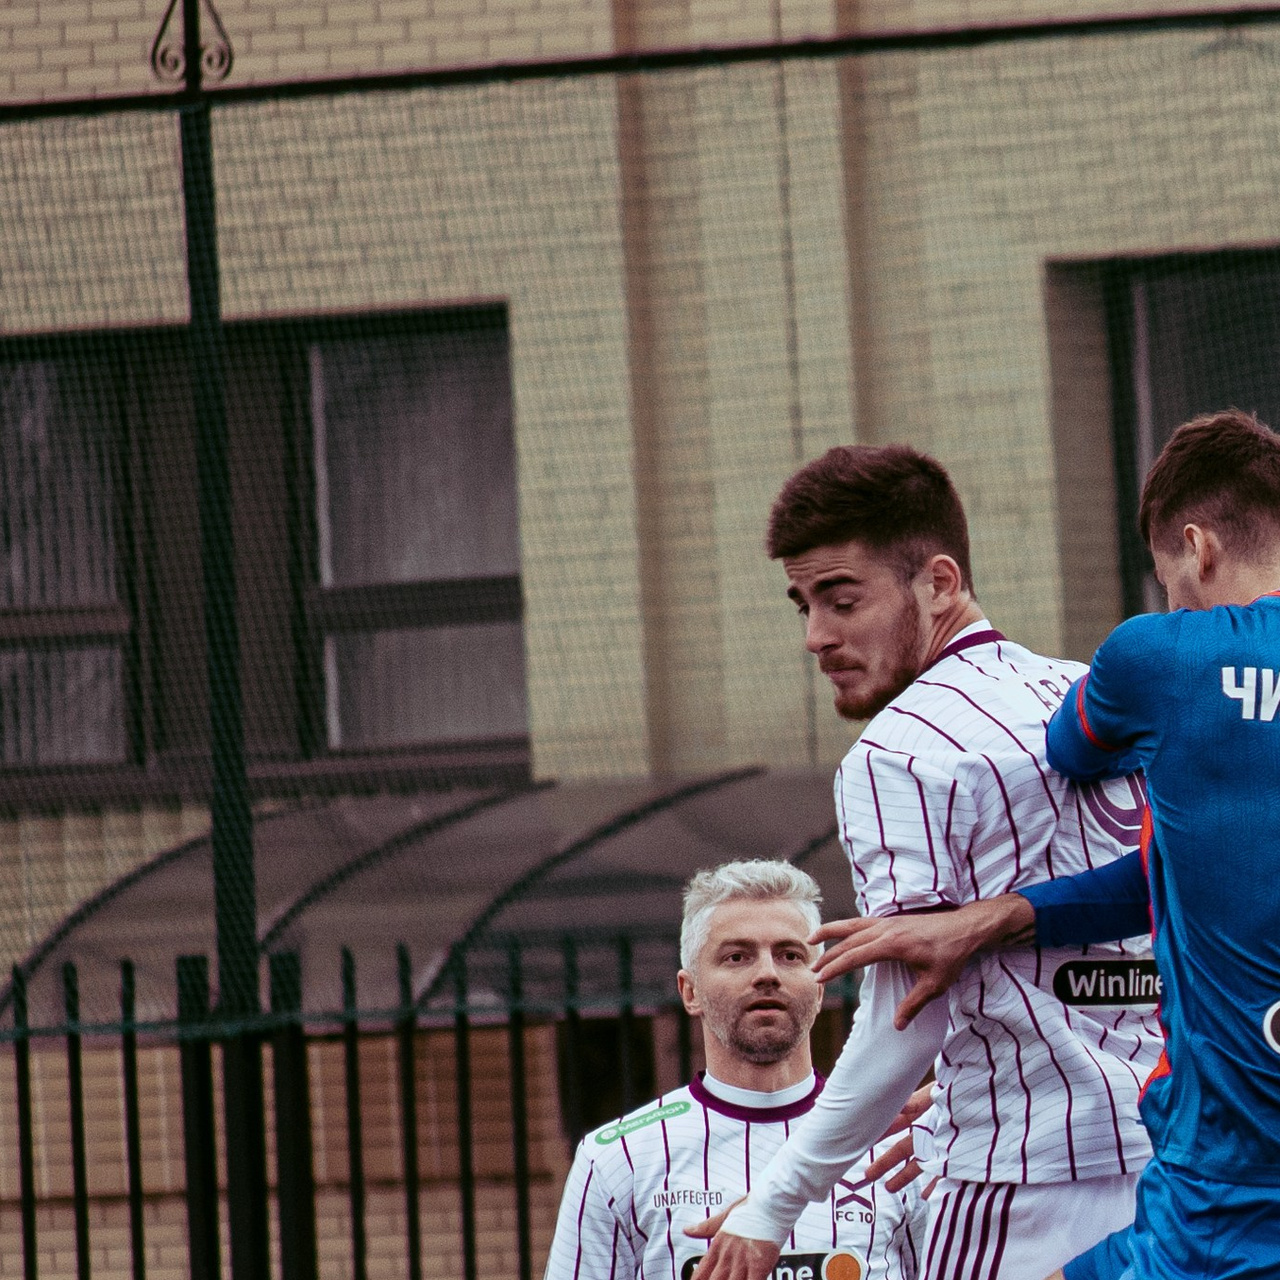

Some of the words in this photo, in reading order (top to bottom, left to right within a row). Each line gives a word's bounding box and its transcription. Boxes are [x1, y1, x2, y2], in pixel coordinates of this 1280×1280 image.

[653, 1189, 723, 1209] UNAFFECTED
[835, 1210, 855, 1222] FC
[858, 1211, 874, 1224] 10
